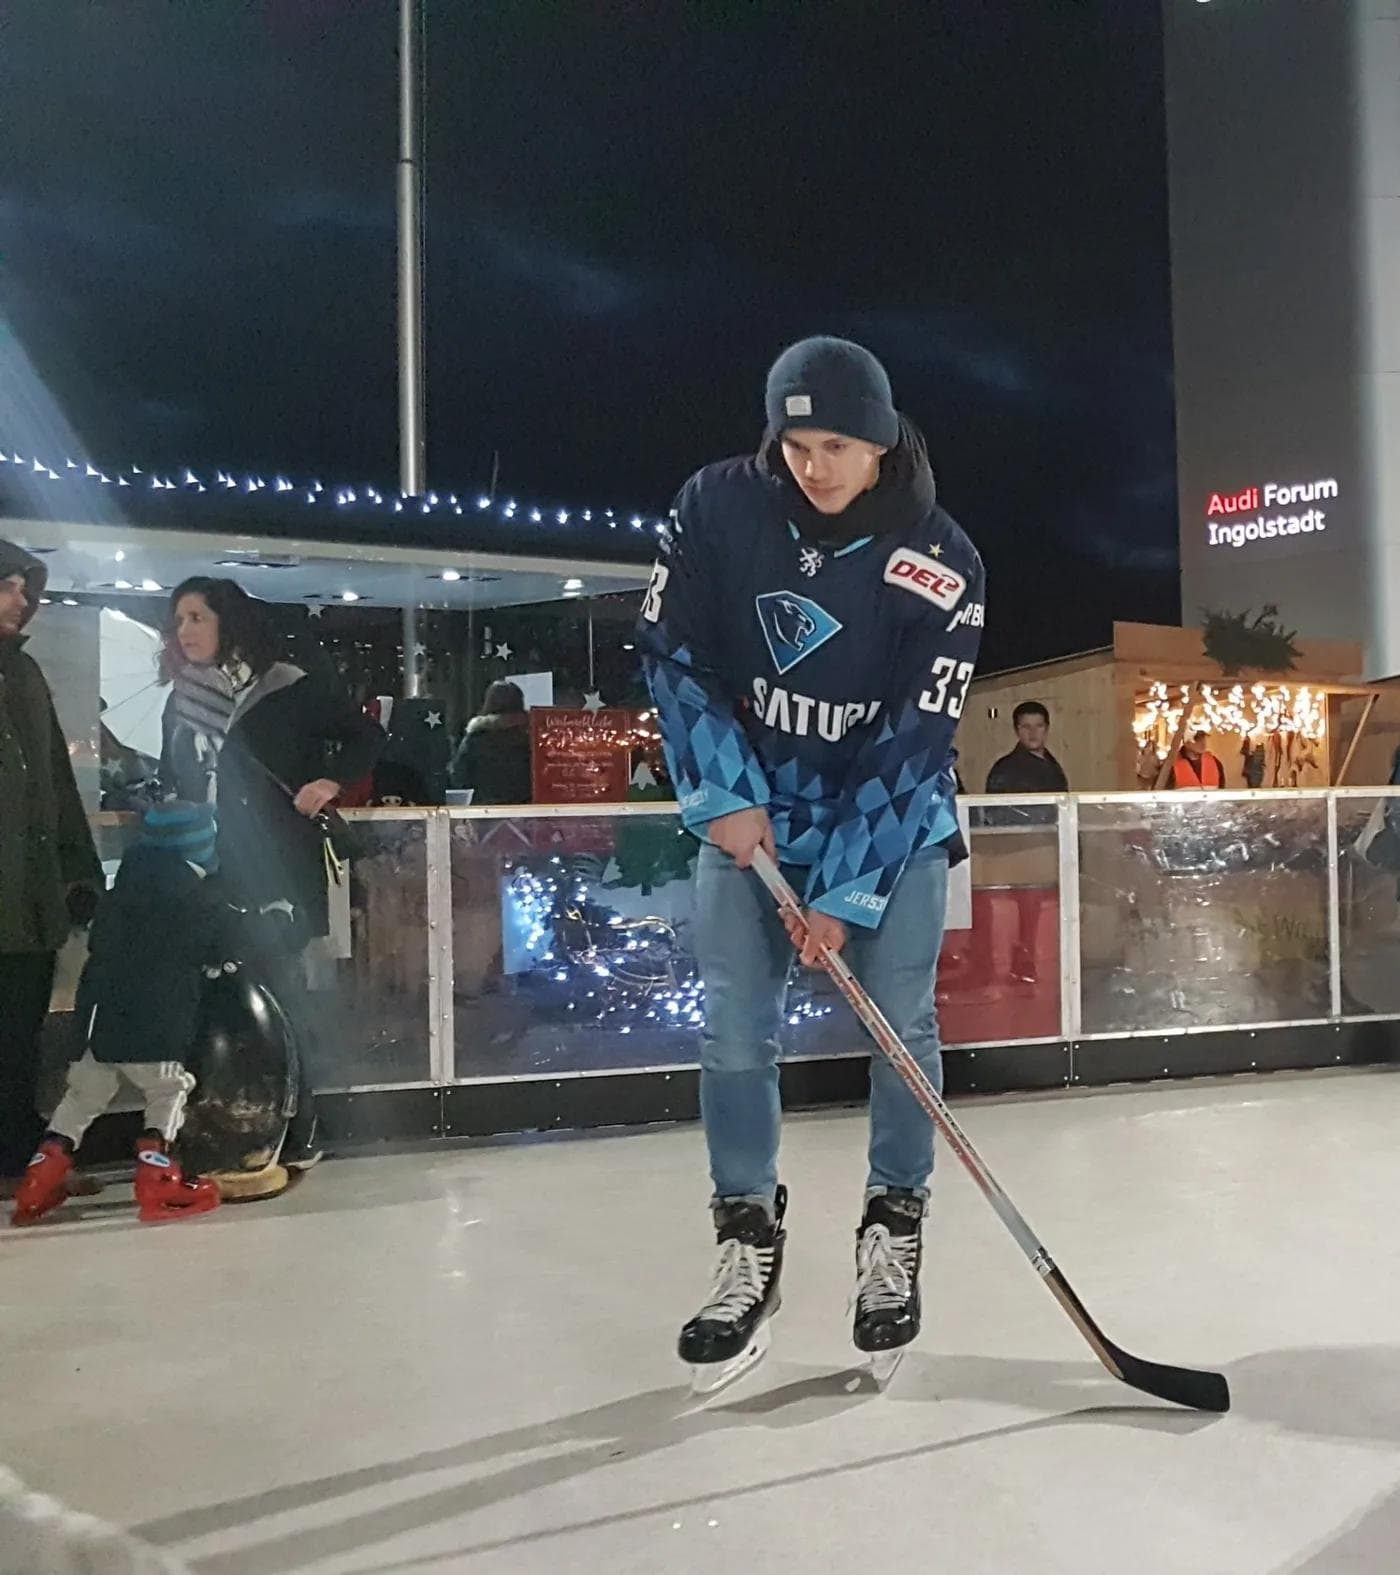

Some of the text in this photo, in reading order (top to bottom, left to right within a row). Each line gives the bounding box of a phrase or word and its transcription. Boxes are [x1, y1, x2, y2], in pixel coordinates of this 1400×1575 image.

[1207, 479, 1338, 516] Audi Forum
[1208, 509, 1326, 547] Ingolstadt
[918, 656, 975, 720] 33
